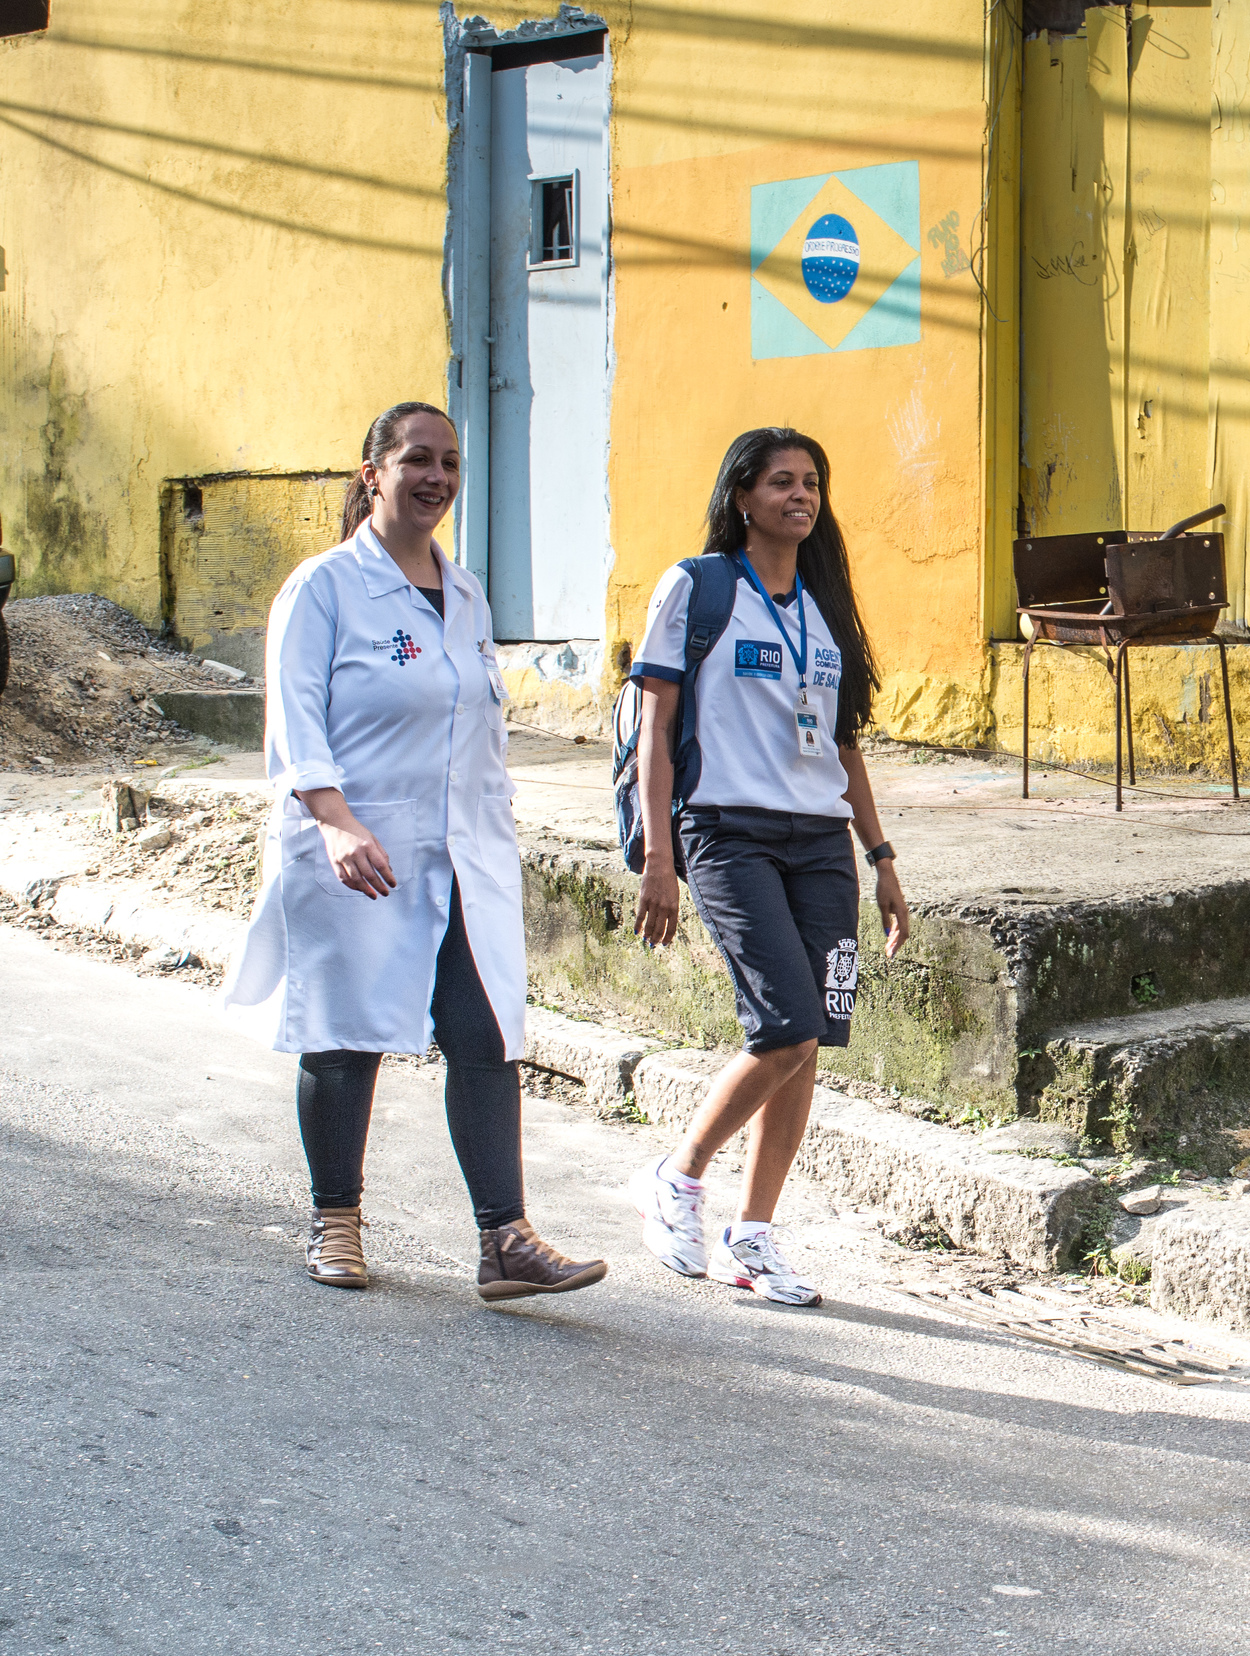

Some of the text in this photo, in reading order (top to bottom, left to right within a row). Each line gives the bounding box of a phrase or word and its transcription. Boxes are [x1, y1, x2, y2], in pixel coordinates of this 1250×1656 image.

[760, 649, 781, 664] RIO
[813, 671, 826, 686] DE
[826, 990, 855, 1013] RIO
